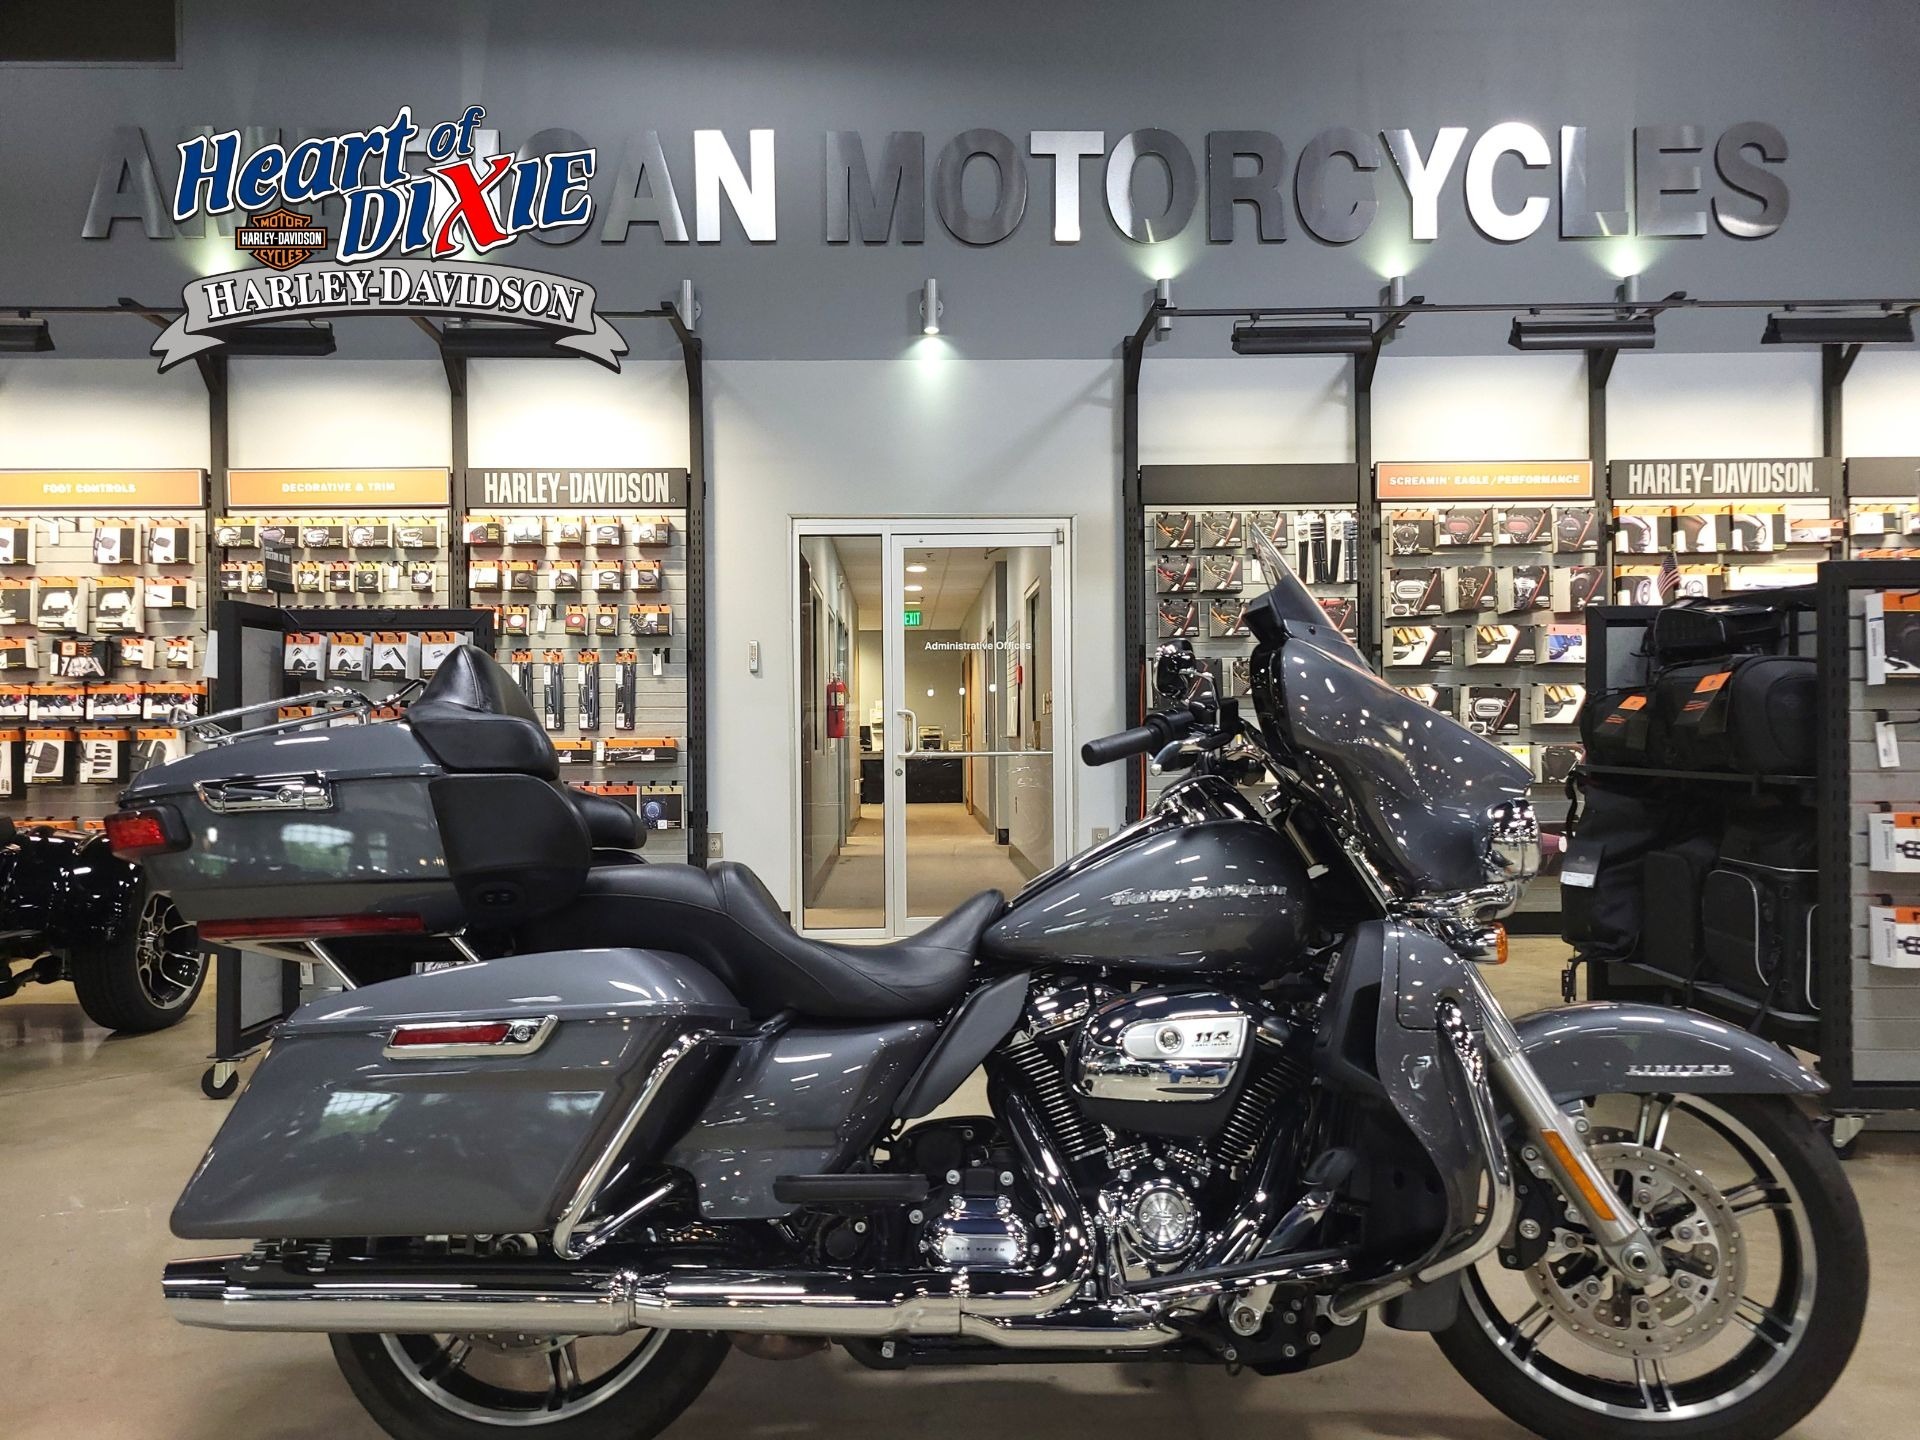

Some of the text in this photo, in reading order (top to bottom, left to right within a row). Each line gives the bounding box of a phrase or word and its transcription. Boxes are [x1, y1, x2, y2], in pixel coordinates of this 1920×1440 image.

[826, 120, 1791, 246] MOTORCYCLES
[1389, 475, 1451, 486] SCREAMIN'
[1628, 462, 1814, 494] HARLEY-DAVIDSON
[43, 483, 136, 494] FOOT CONTROLS
[282, 481, 396, 493] DECORATIVE & TRIM
[484, 472, 670, 503] HARLEY-DAVIDSON
[904, 612, 921, 625] EXIT
[924, 641, 994, 651] Administrative
